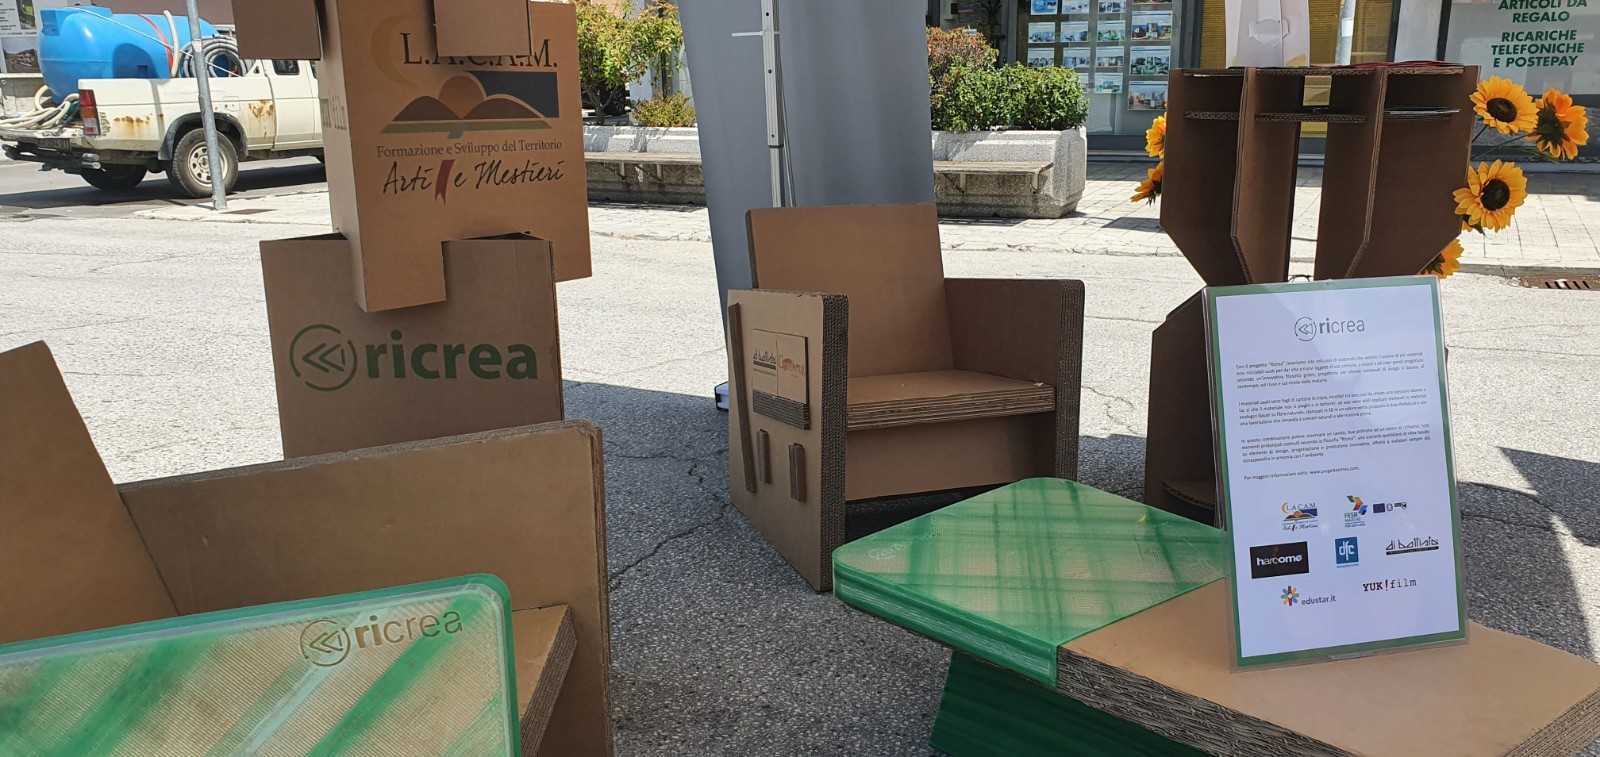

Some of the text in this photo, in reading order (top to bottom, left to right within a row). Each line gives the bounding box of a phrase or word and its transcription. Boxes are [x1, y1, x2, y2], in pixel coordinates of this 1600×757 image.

[1498, 0, 1588, 10] ARTICOLI DA
[1512, 11, 1570, 23] REGALO
[1501, 30, 1577, 42] RICARICHE
[1491, 42, 1585, 55] TELEFONICHE
[1493, 56, 1578, 67] E POSTEPAY
[376, 145, 445, 158] Formazione
[454, 141, 499, 156] Sviluppo
[502, 140, 516, 152] del
[518, 139, 562, 151] Territorio
[382, 160, 565, 195] Arti e Mestieri
[1319, 317, 1365, 334] ricrea
[366, 329, 538, 380] ricrea
[1301, 594, 1336, 606] edustar.it
[354, 611, 463, 649] ricrea
